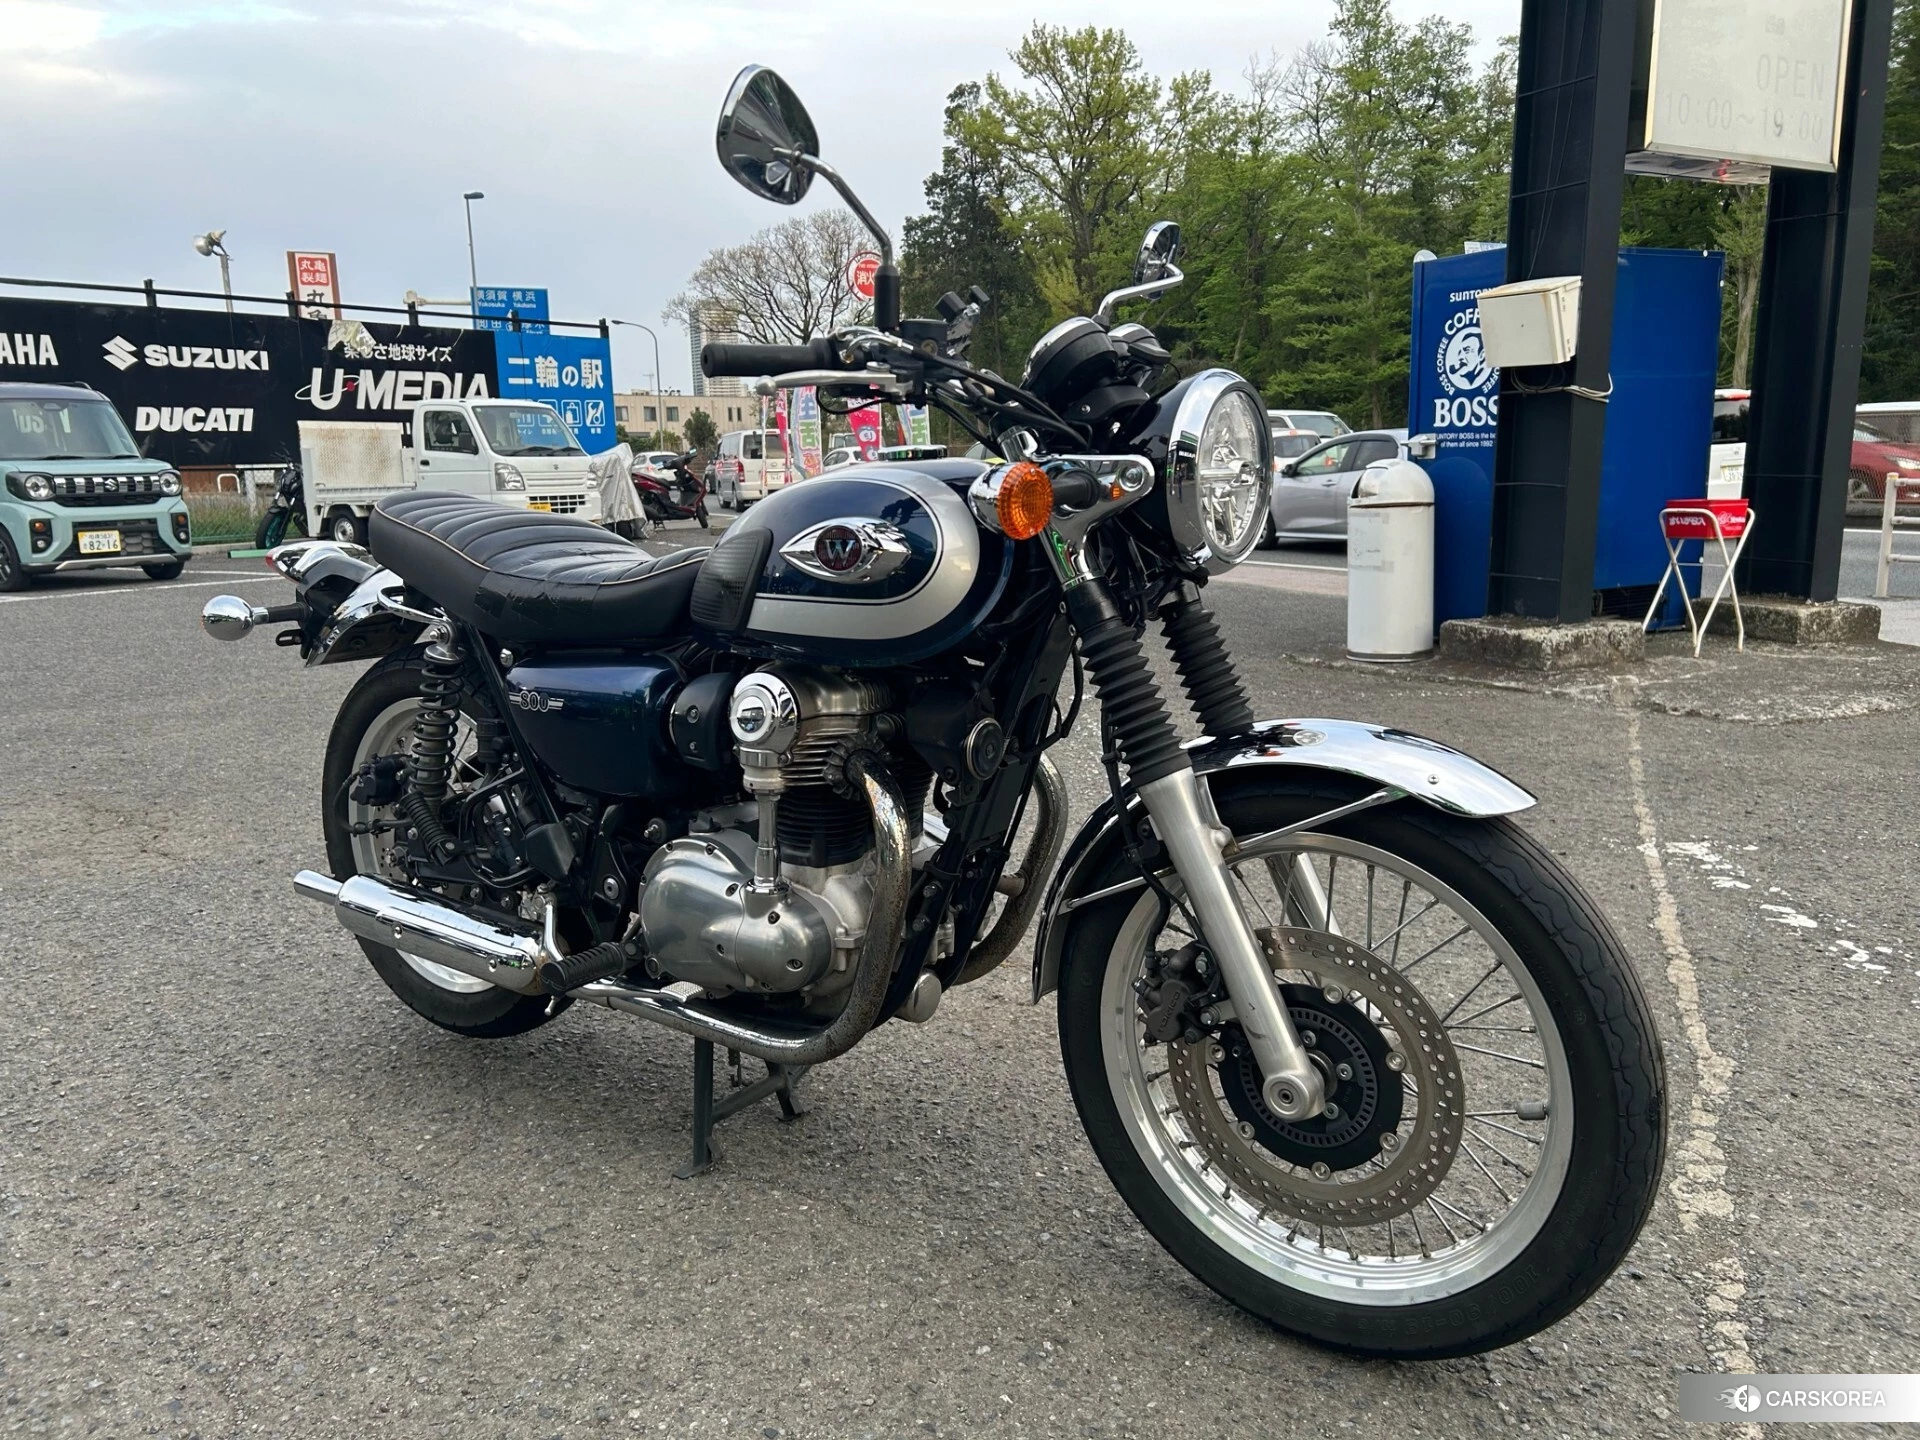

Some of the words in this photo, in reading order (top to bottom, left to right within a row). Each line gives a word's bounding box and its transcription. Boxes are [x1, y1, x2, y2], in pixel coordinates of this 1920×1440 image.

[1756, 54, 1825, 101] OPEN
[143, 344, 270, 371] SUZUKI
[507, 355, 604, 389] 二輪の駅
[135, 406, 254, 433] DUCATI
[1433, 395, 1499, 428] BOSS
[1459, 432, 1474, 440] BOSS
[1480, 432, 1489, 440] the
[823, 539, 856, 568] W
[519, 690, 550, 712] 800
